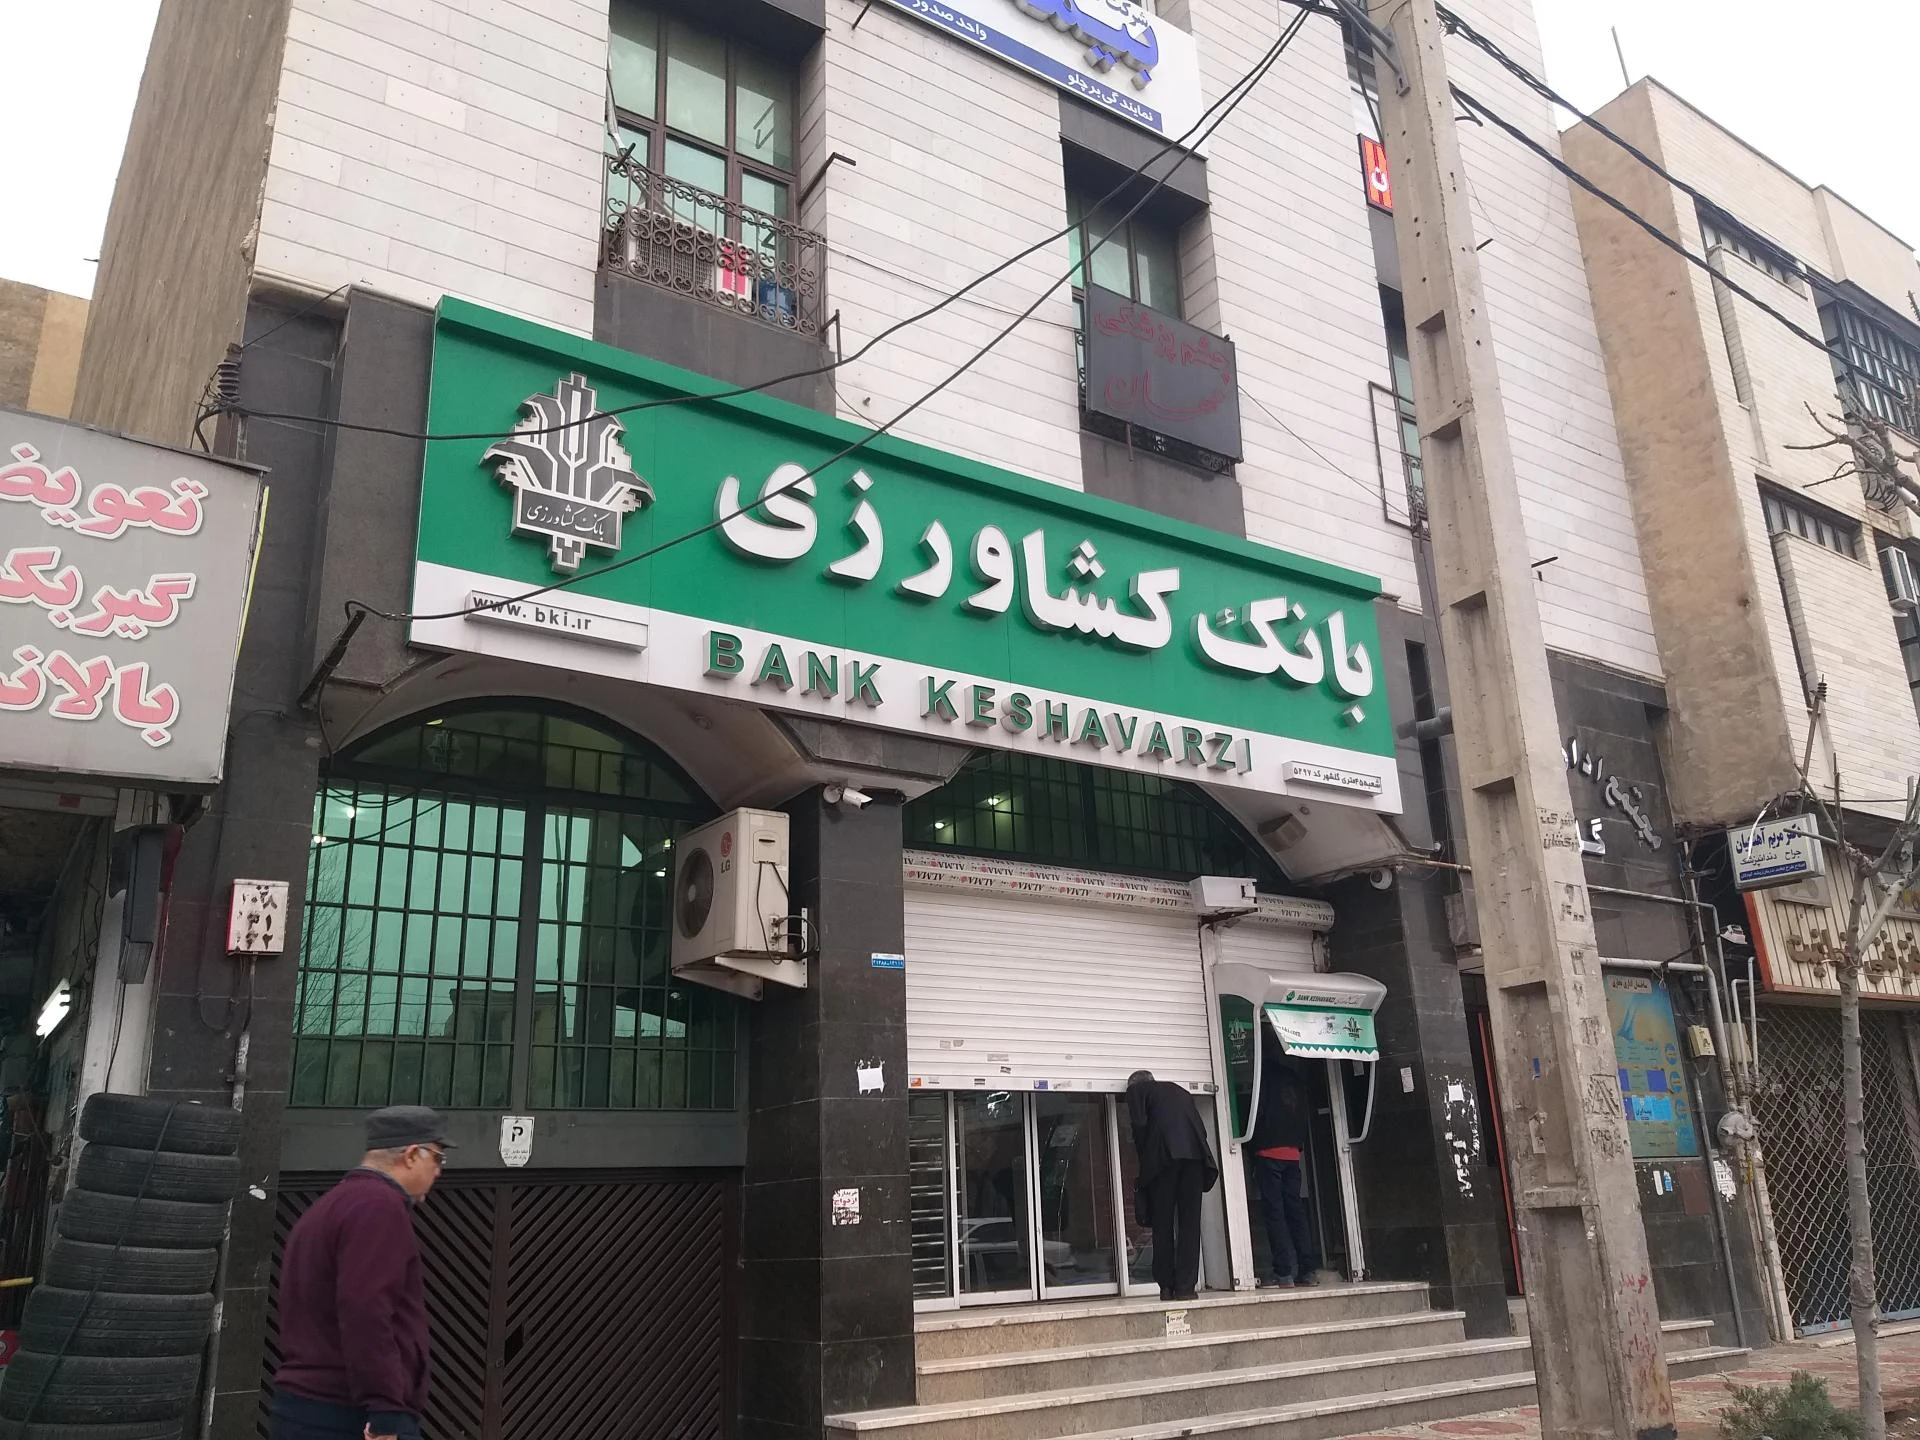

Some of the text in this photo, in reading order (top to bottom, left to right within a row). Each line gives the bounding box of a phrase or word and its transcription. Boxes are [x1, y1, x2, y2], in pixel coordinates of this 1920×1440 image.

[956, 15, 987, 41] واحد
[526, 503, 611, 541] بانک کشاورزی
[0, 547, 196, 640] گیربک
[714, 462, 1373, 727] بانک کشاورزی
[0, 644, 179, 747] بالان
[704, 630, 1253, 776] BANK KESHAVARZI
[720, 859, 731, 873] LG
[1785, 848, 1802, 860] جراح
[512, 1126, 523, 1142] P
